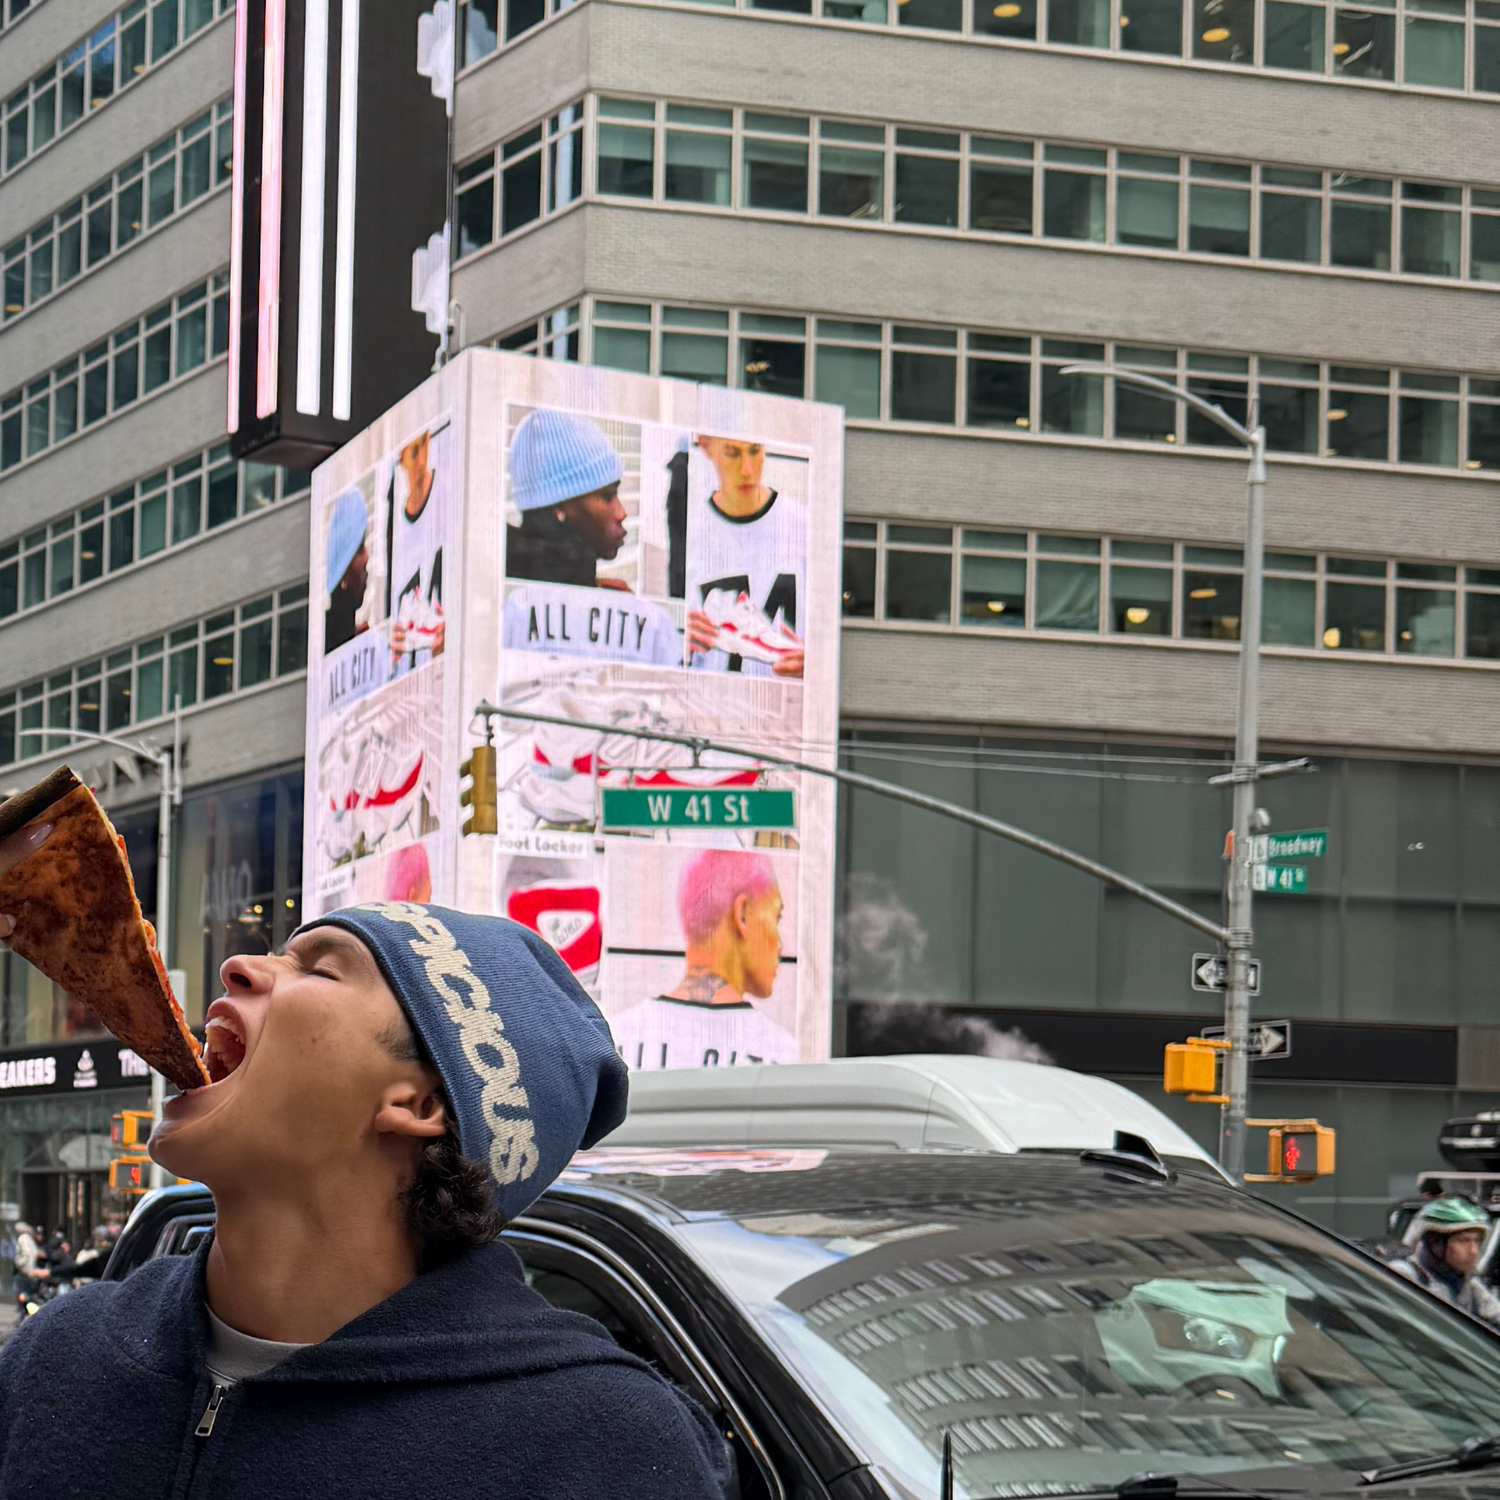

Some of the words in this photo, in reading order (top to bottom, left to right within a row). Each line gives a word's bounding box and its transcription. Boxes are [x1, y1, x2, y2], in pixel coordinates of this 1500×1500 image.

[528, 604, 570, 643] ALL
[588, 607, 647, 650] CITY
[648, 795, 672, 822] W
[685, 795, 711, 822] 41
[724, 795, 751, 822] St
[535, 836, 583, 853] Locker
[1269, 835, 1323, 858] Broadway
[1279, 867, 1292, 890] 41
